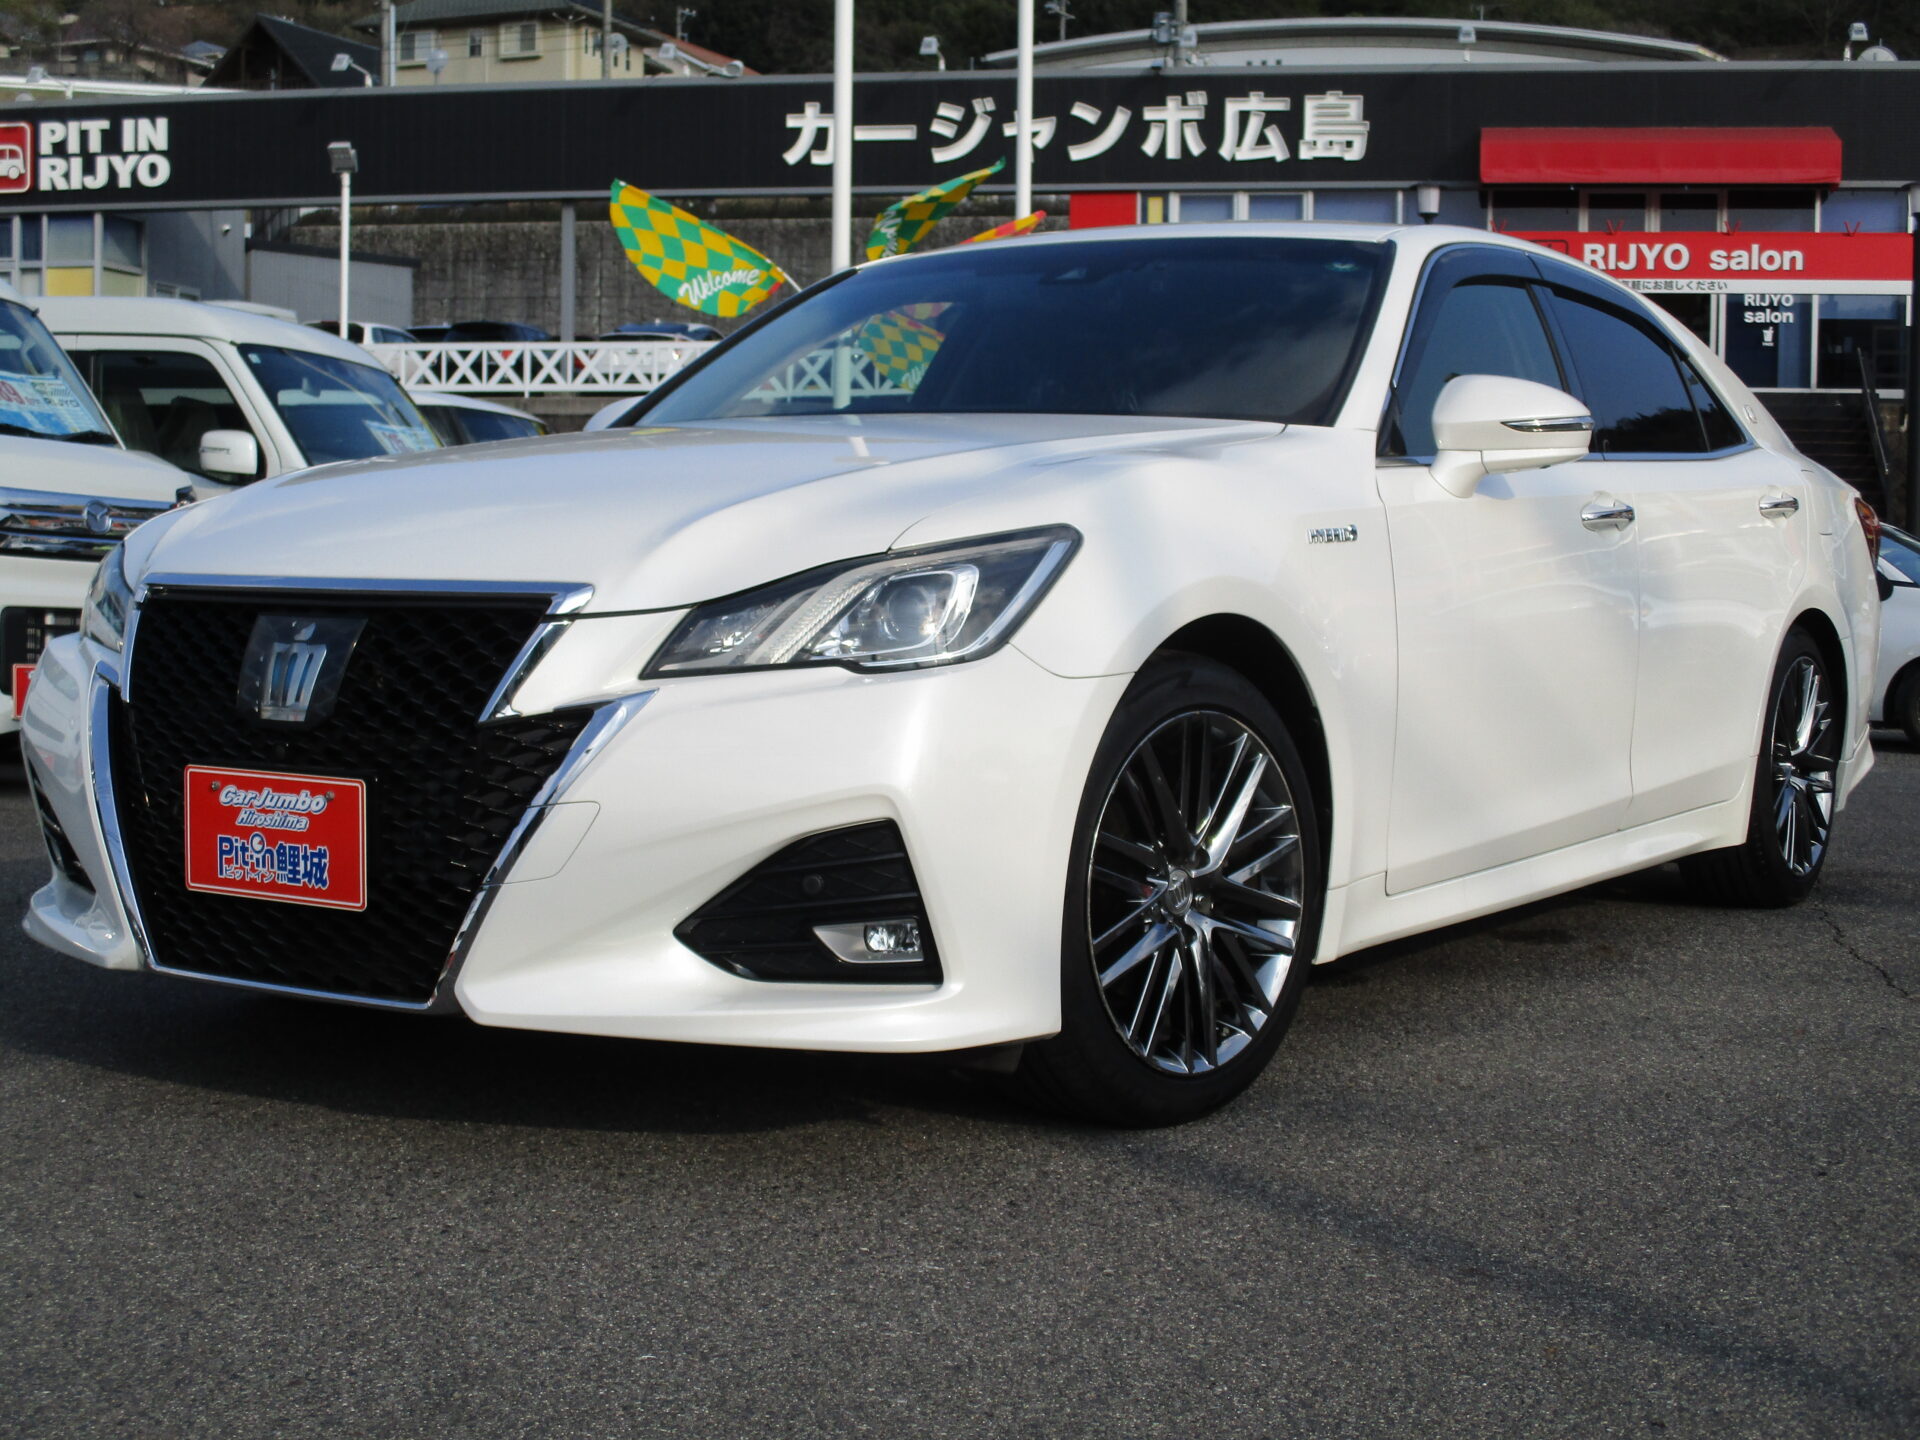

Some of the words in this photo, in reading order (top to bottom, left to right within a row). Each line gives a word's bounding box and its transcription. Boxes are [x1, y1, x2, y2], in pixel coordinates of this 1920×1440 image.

[39, 119, 111, 155] PIT
[122, 117, 169, 152] IN
[782, 90, 1370, 166] カージャンボ広島
[38, 153, 171, 191] RIJYO
[1583, 243, 1691, 271] RIJYO
[1709, 244, 1805, 271] salon
[677, 268, 761, 306] Welcome
[1744, 294, 1794, 307] RIJYO
[1744, 308, 1794, 324] salon
[235, 808, 309, 832] Hiroshima
